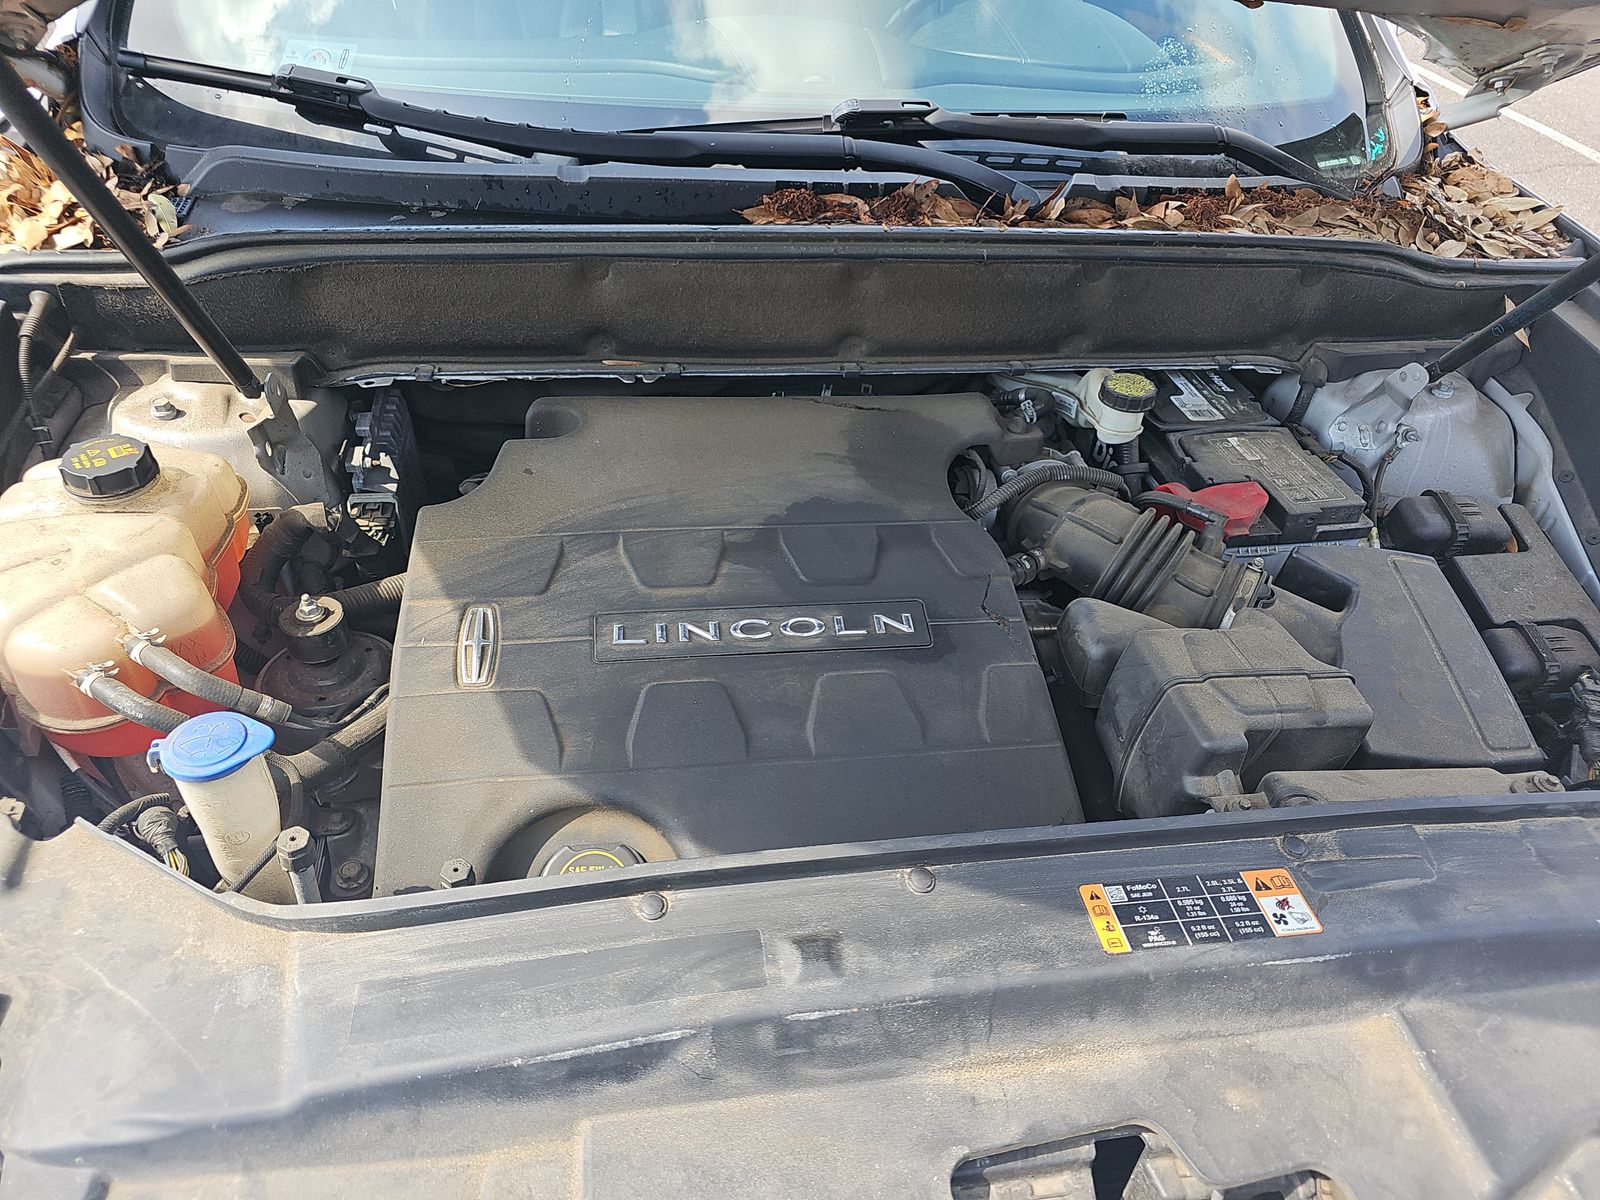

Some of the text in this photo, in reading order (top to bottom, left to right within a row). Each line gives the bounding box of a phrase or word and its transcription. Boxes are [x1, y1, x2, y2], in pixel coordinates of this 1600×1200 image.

[612, 612, 915, 646] LINCOLN
[568, 866, 587, 874] SAE
[1126, 884, 1157, 892] FoMoCo
[1194, 899, 1205, 907] kg
